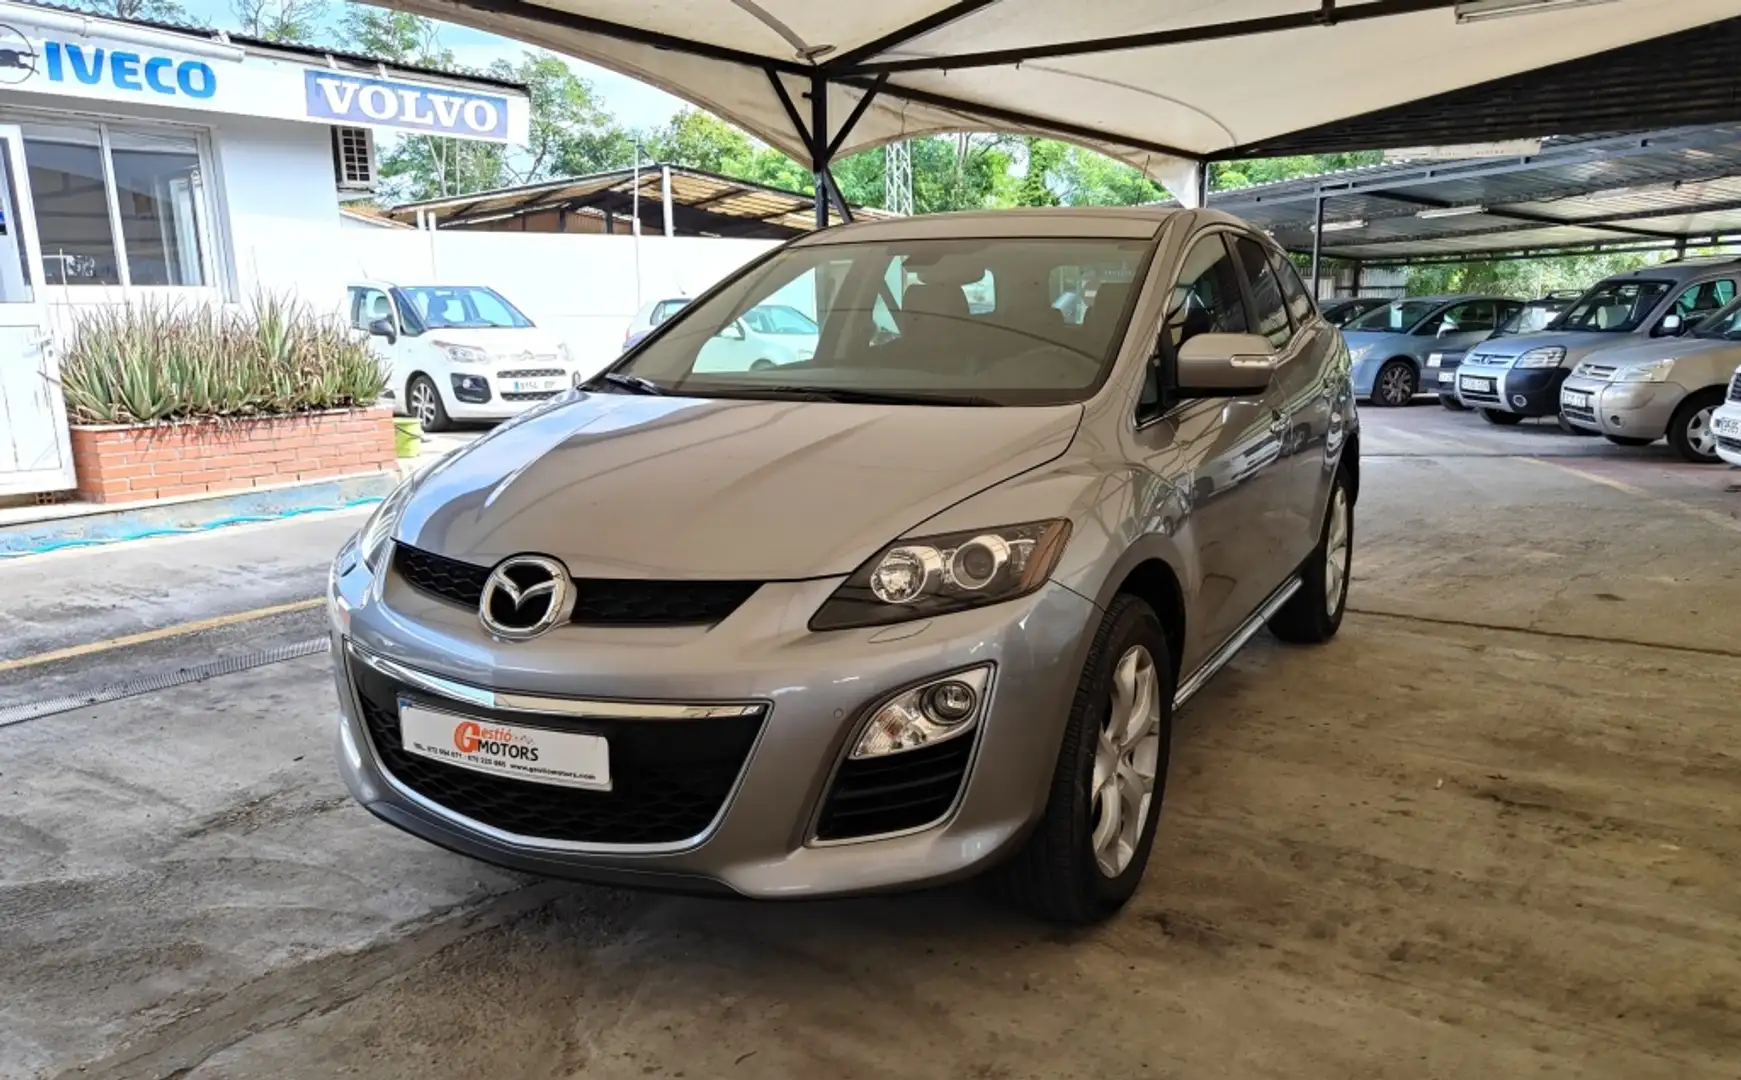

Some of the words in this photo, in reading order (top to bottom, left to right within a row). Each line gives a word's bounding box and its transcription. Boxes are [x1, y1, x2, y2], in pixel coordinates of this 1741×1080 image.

[45, 41, 217, 99] IVECO
[316, 78, 498, 132] VOLVO
[478, 740, 539, 762] MOTORS
